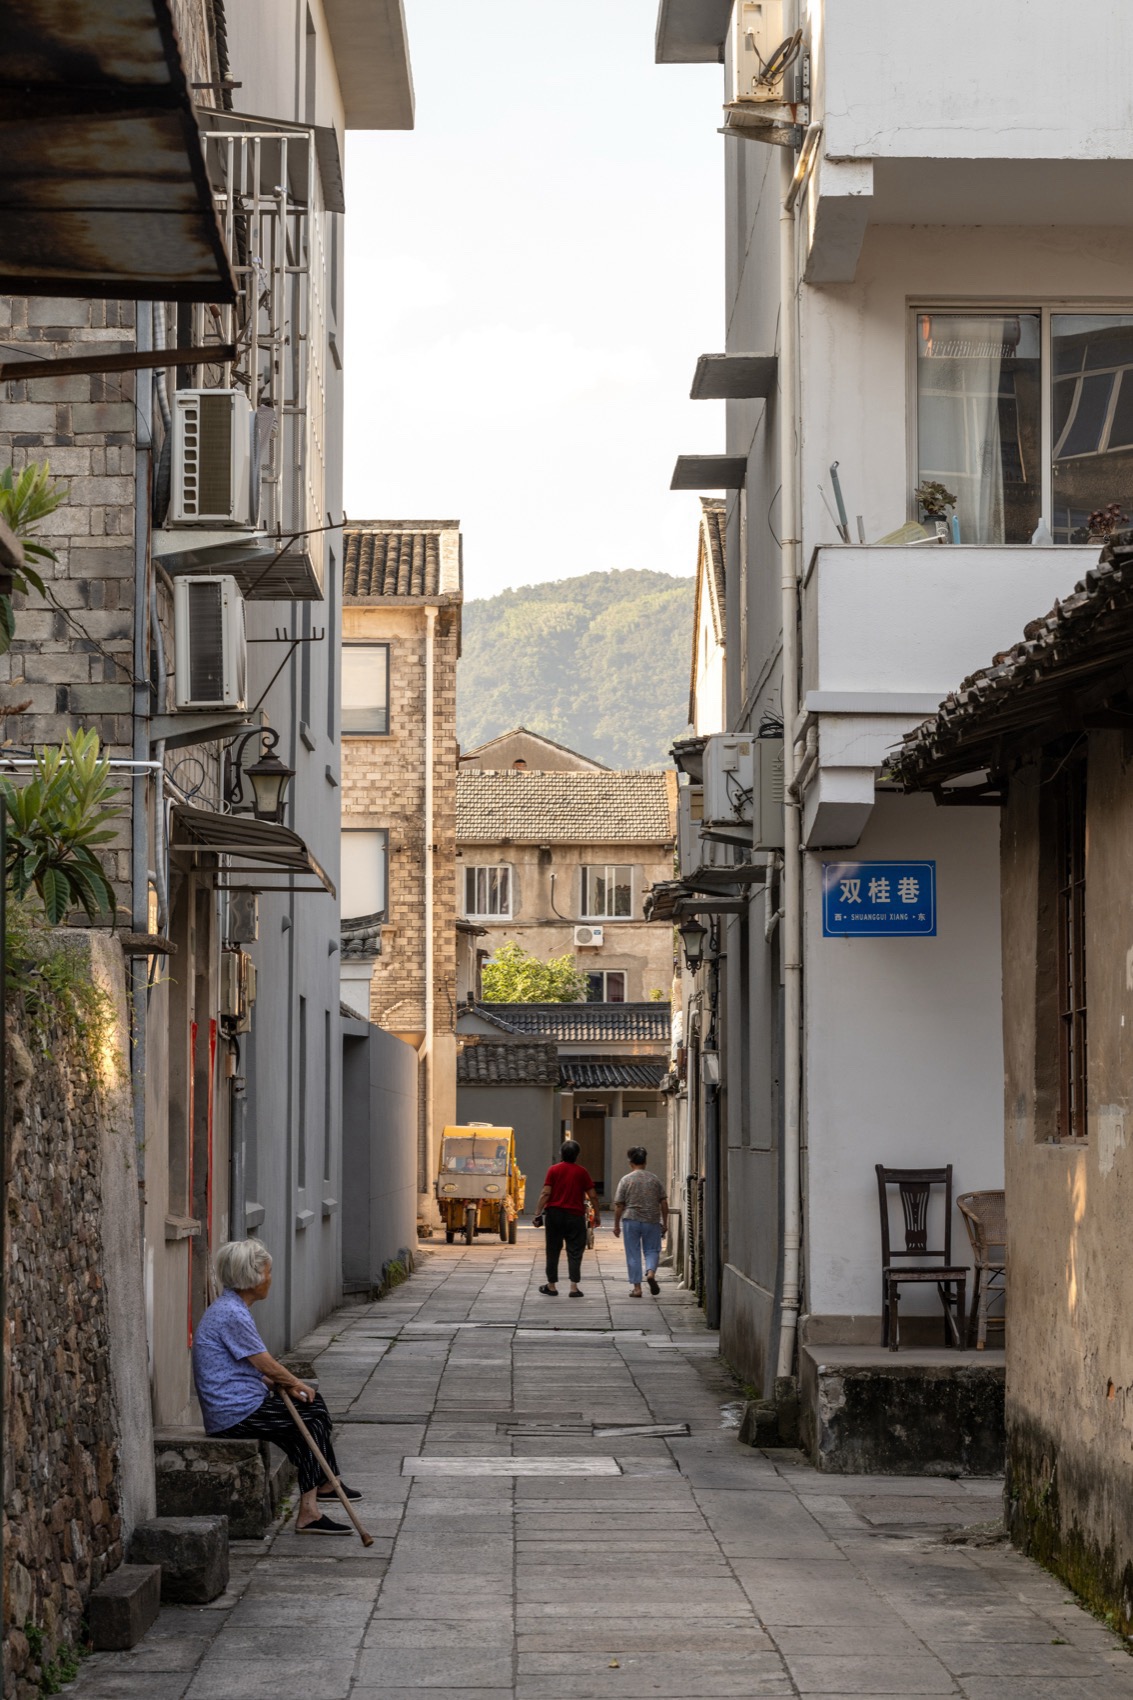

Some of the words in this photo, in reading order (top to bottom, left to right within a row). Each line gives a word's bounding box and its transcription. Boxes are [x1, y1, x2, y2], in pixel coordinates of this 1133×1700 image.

[839, 877, 920, 904] 双桂巷
[834, 913, 842, 921] 西
[851, 913, 887, 921] SHUANGGUI
[889, 913, 908, 921] XIANG
[917, 913, 926, 921] 东
